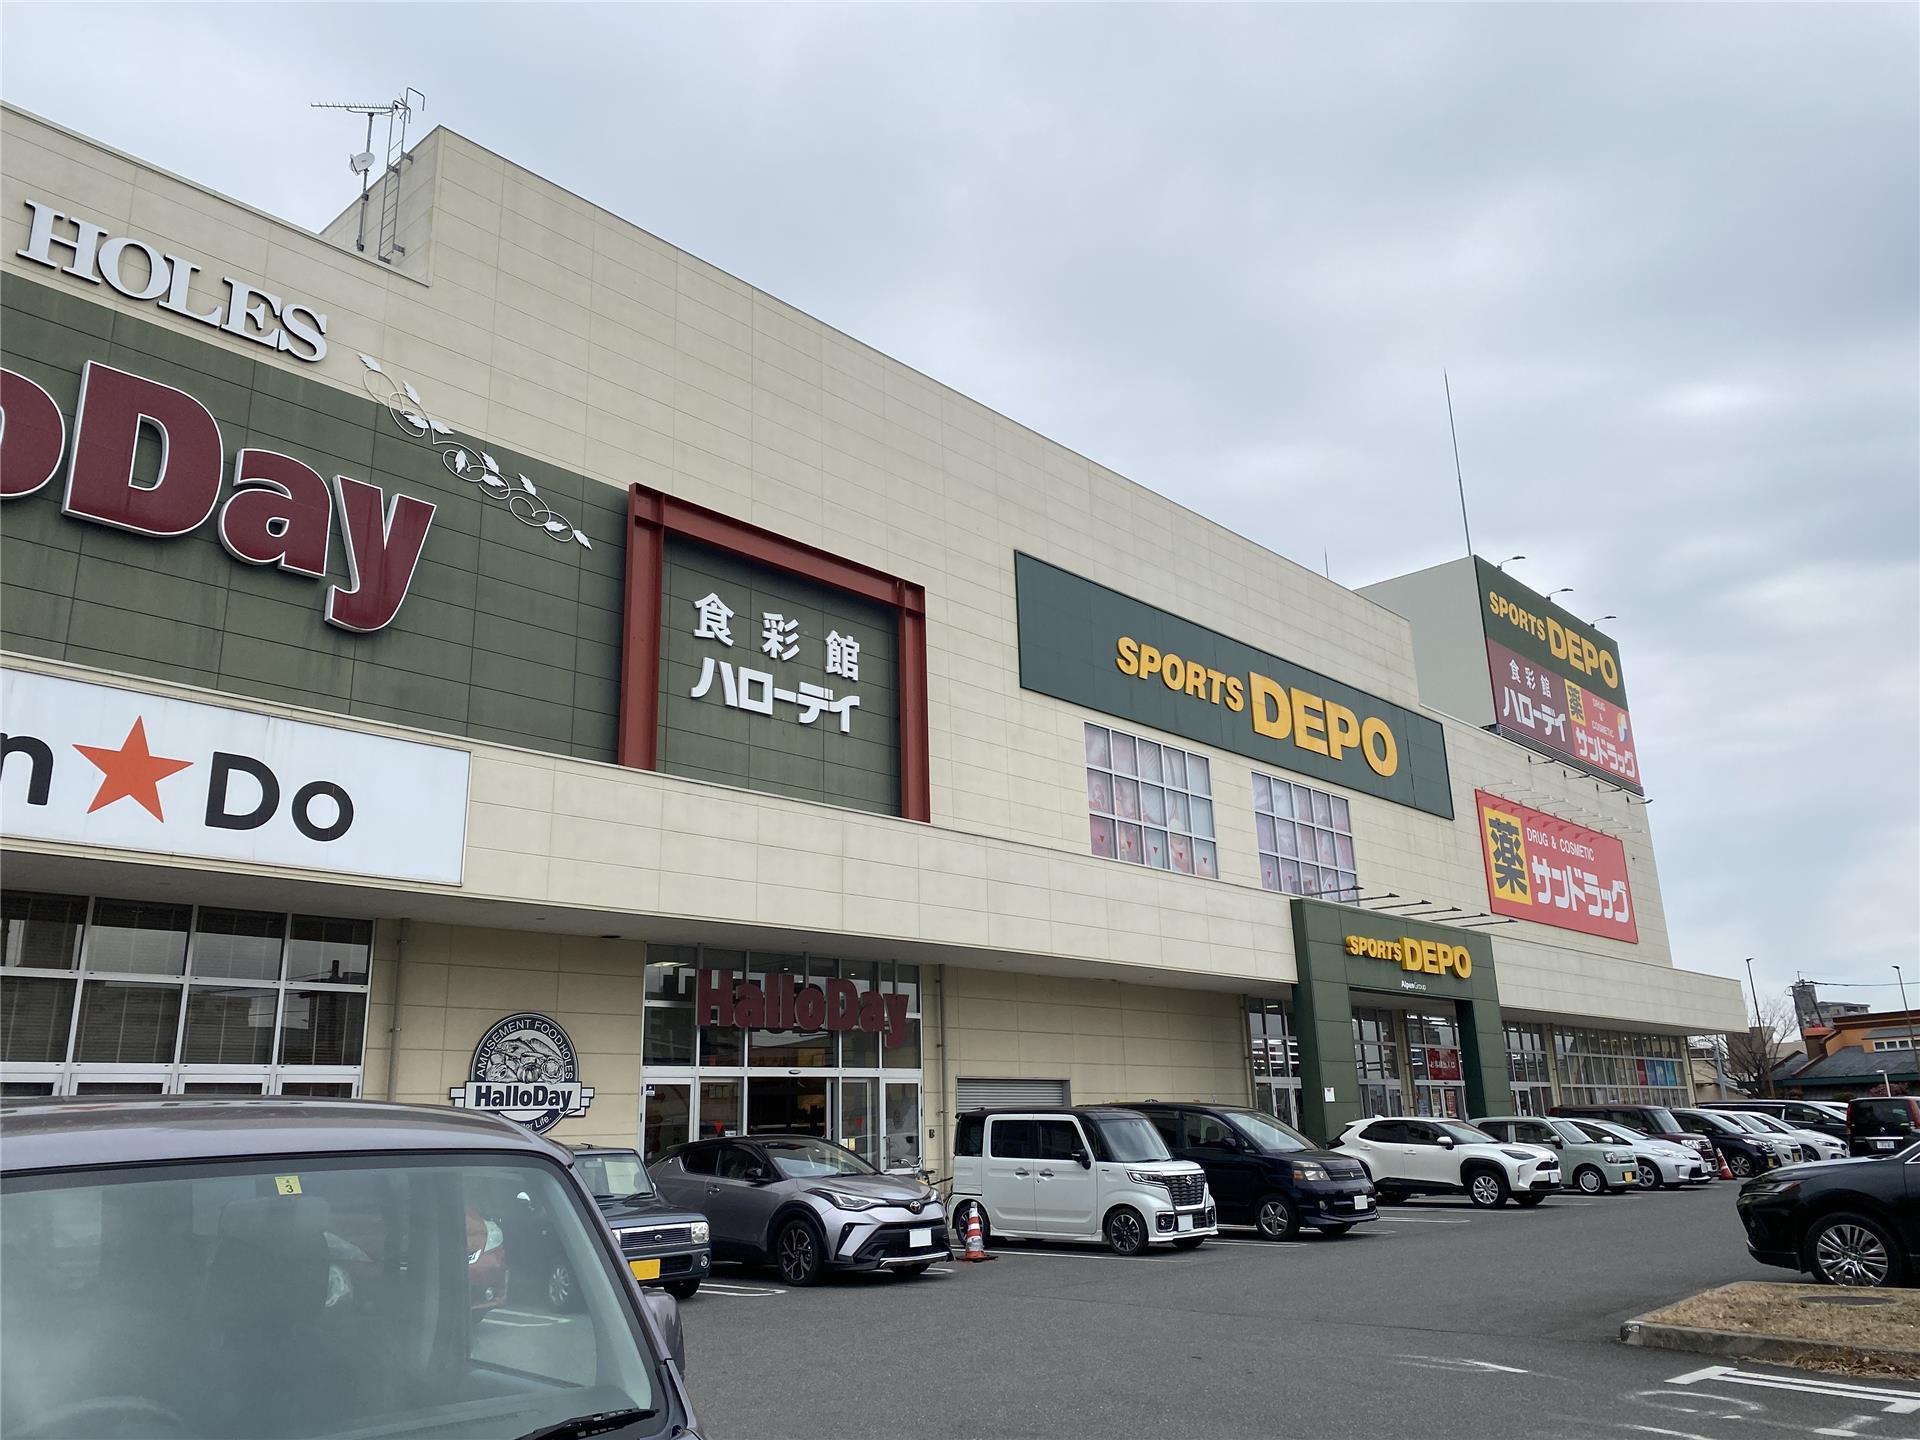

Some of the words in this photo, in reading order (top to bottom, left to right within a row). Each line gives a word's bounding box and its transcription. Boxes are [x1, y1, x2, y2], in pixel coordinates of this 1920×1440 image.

[16, 199, 328, 363] HOLES
[694, 592, 860, 682] 食彩館
[1489, 591, 1546, 642] SPORTS
[1546, 616, 1619, 689] DEPO
[1116, 636, 1244, 712] SPORTS
[1248, 671, 1399, 778] DEPO
[1575, 727, 1636, 778] サンドラッグ
[205, 751, 354, 841] Do
[1488, 817, 1528, 896] 薬
[1526, 827, 1549, 847] DRUG
[1551, 835, 1558, 850] &
[1559, 838, 1595, 862] COSMETIC
[1531, 855, 1630, 924] サンドラッグ
[1345, 935, 1403, 962] SPORTS
[1399, 936, 1473, 979] DEPO
[695, 968, 910, 1048] HalloDay
[476, 1019, 532, 1078] AMUSEMENT
[475, 1085, 573, 1113] HalloDay
[285, 1184, 294, 1194] 3
